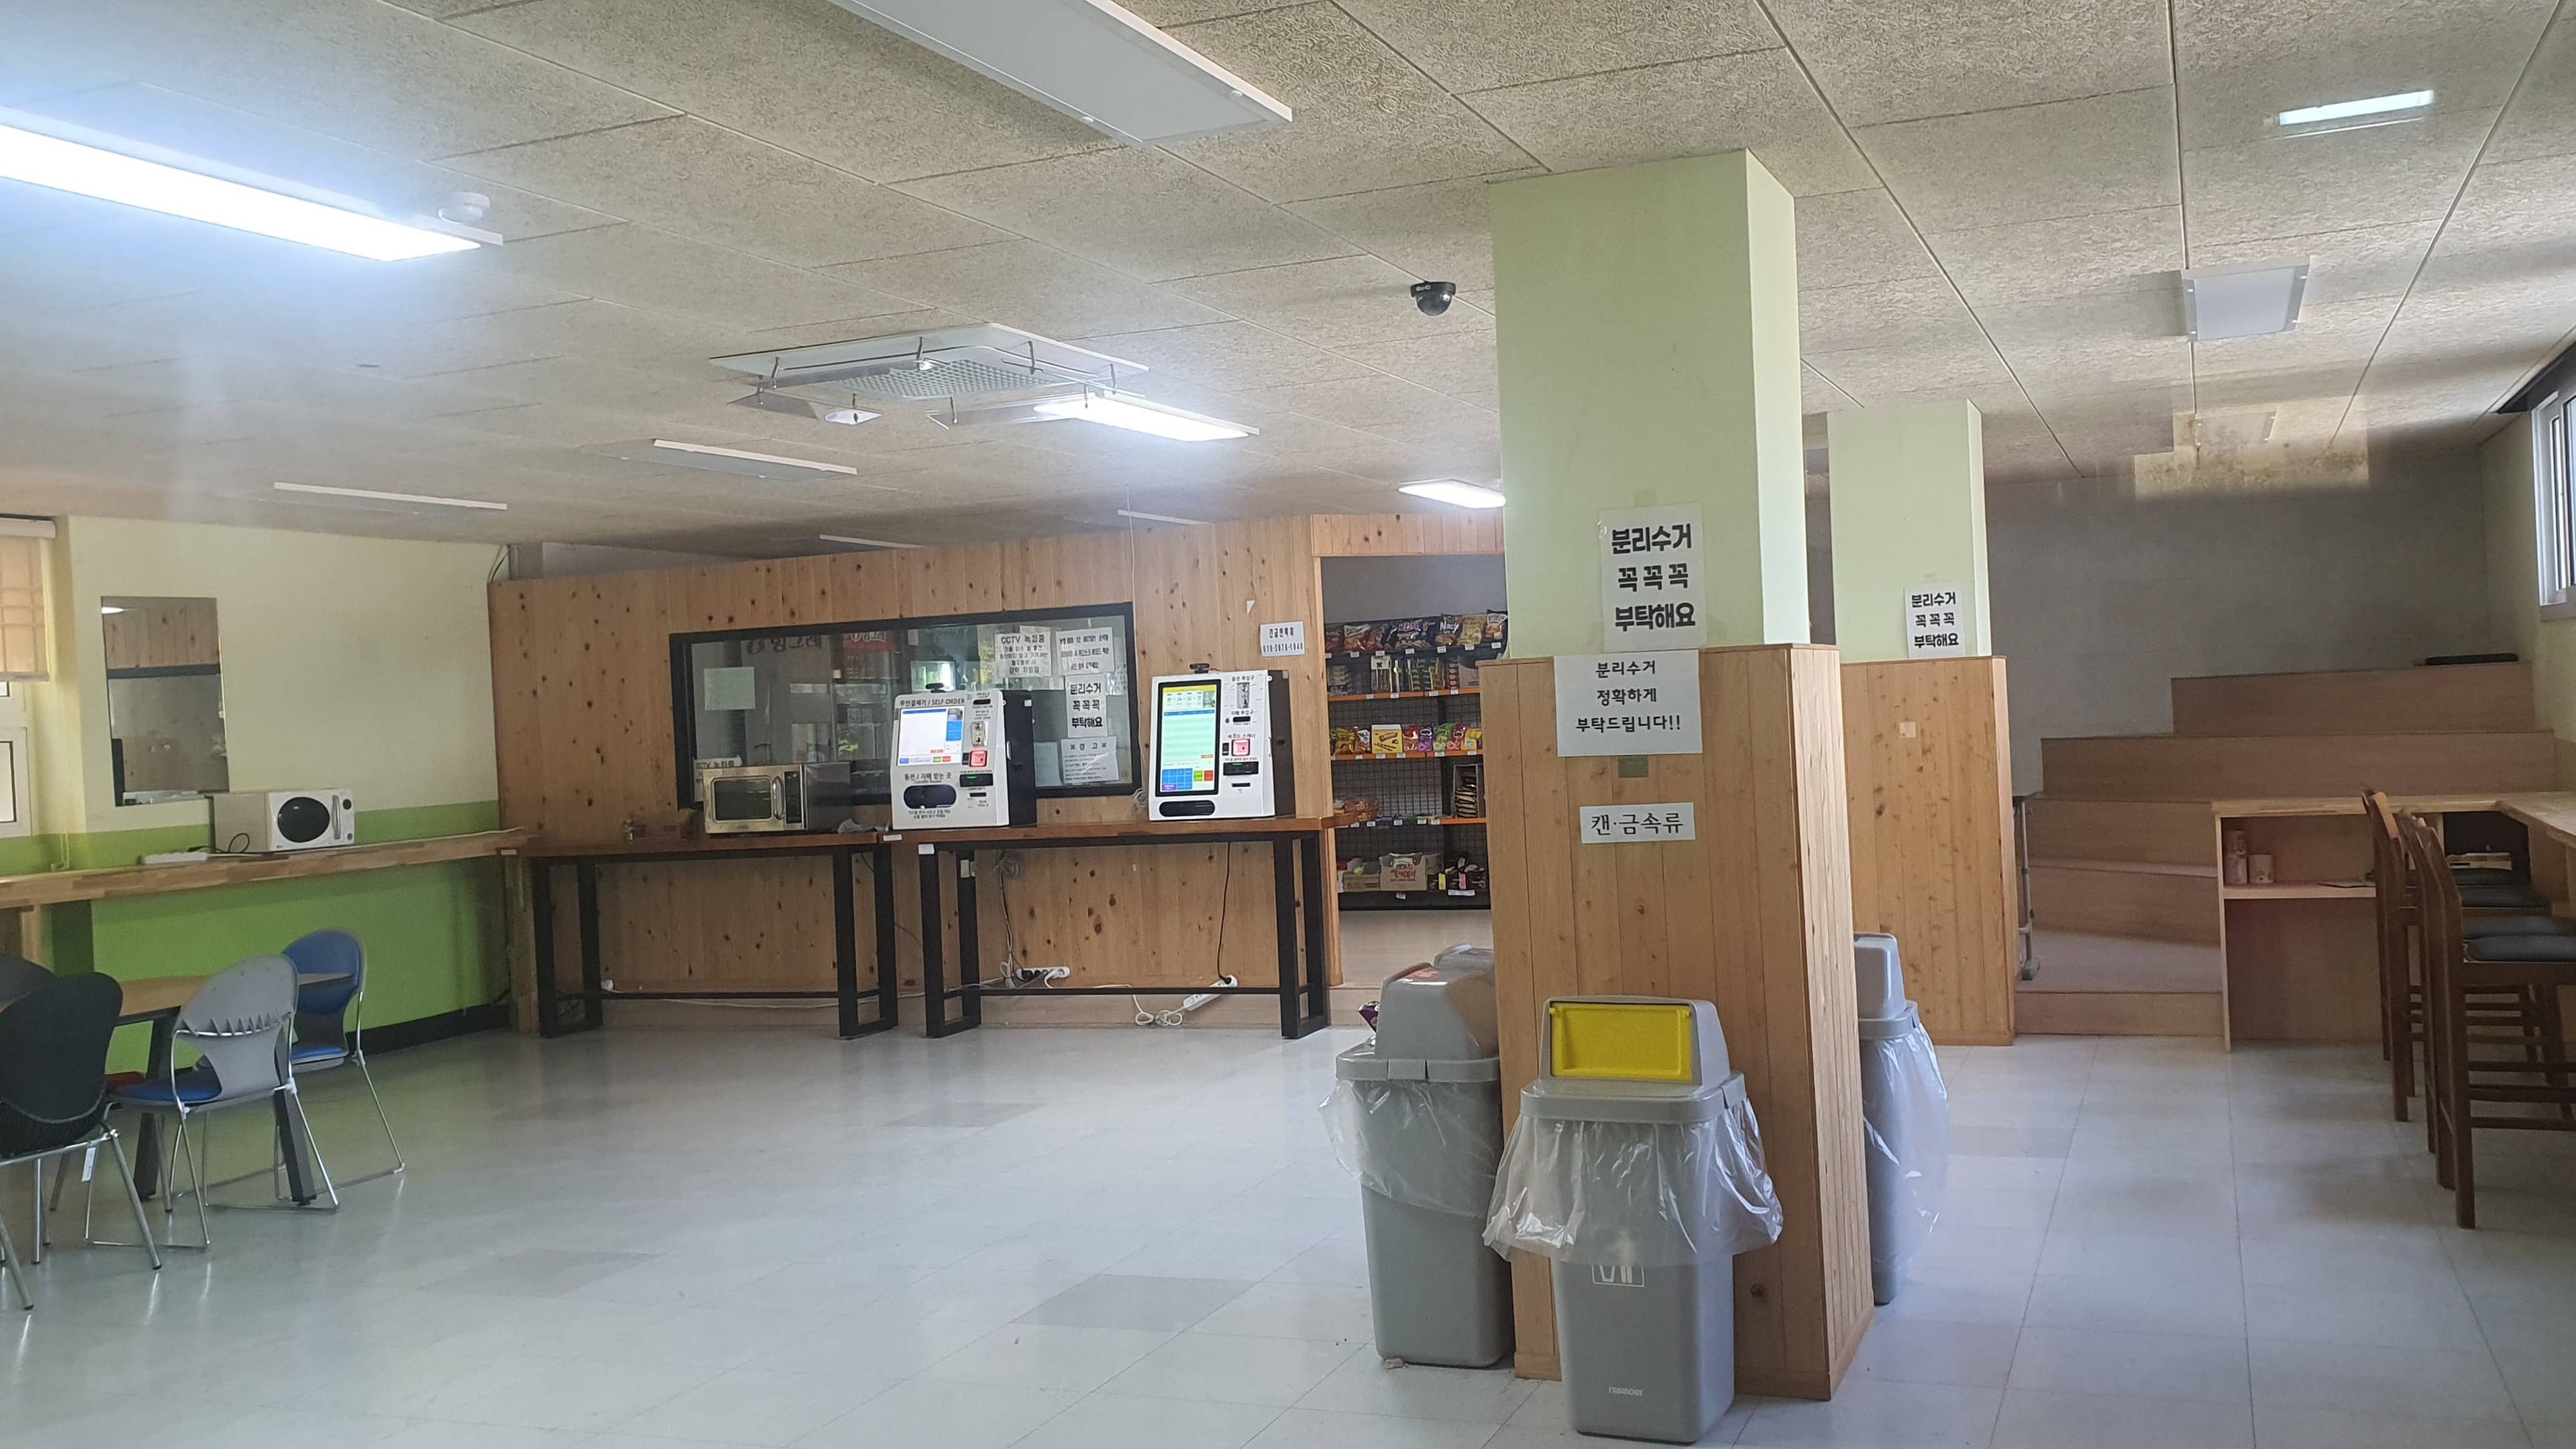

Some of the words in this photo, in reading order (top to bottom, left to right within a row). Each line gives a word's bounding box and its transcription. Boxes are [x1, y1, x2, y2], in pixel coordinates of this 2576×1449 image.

[1611, 523, 1692, 554] 분리수거
[1618, 567, 1638, 592] 꼭
[1643, 565, 1662, 590] 꼭
[1668, 563, 1688, 588] 꼭
[1912, 591, 1956, 608] 분리수거
[1614, 602, 1696, 632] 부탁해요
[1915, 614, 1927, 628] 꼭
[1929, 613, 1941, 627] 꼭
[1943, 612, 1955, 625] 꼭
[1001, 636, 1020, 644] CCTV
[1914, 633, 1960, 649] 부탁해요
[1596, 659, 1656, 678] 분리수거
[1071, 682, 1102, 695] 분리수거
[1597, 687, 1657, 706] 정확하게
[1072, 716, 1103, 729] 부탁해요
[1575, 714, 1680, 734] 부탁드립니다!!
